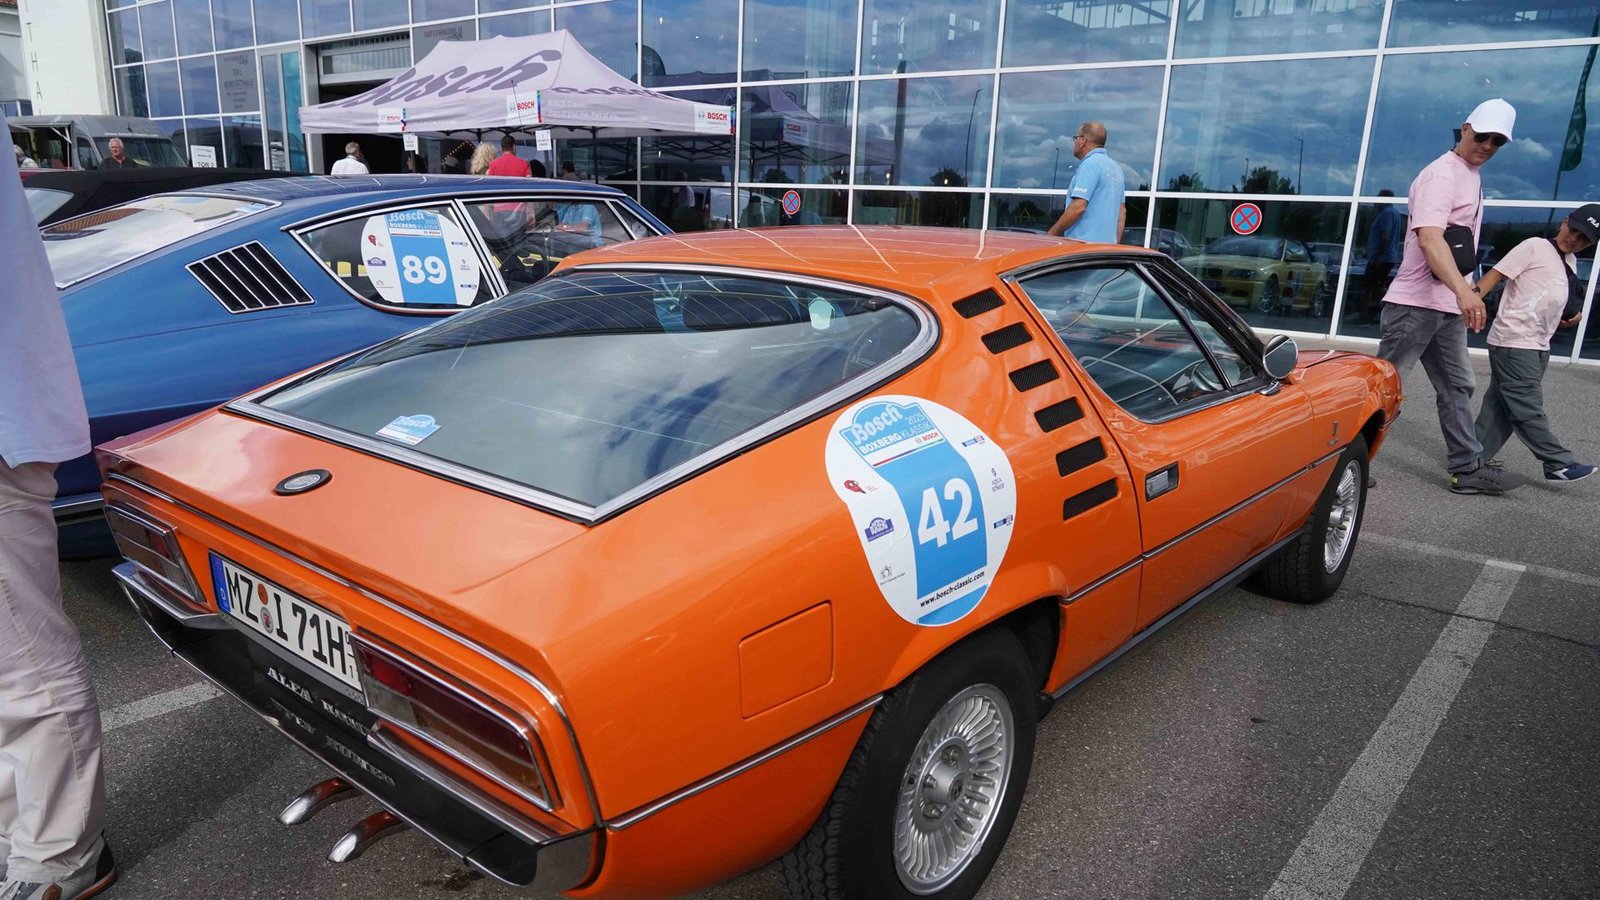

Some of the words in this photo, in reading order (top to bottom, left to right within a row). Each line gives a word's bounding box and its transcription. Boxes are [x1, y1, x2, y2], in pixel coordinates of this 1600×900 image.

[517, 101, 535, 110] BOSCH
[707, 112, 727, 120] BOSCH
[389, 209, 424, 221] Bosch
[402, 255, 447, 285] 89
[851, 403, 904, 446] Bosch
[905, 412, 926, 425] 2025
[859, 432, 903, 455] BOXBERG
[921, 431, 939, 442] BOSCH
[918, 477, 979, 548] 42
[920, 570, 985, 608] www.bosch-classic.com
[225, 566, 259, 623] MZ
[292, 602, 347, 675] 71H
[266, 666, 314, 704] ALFA
[320, 699, 368, 737] ROME
